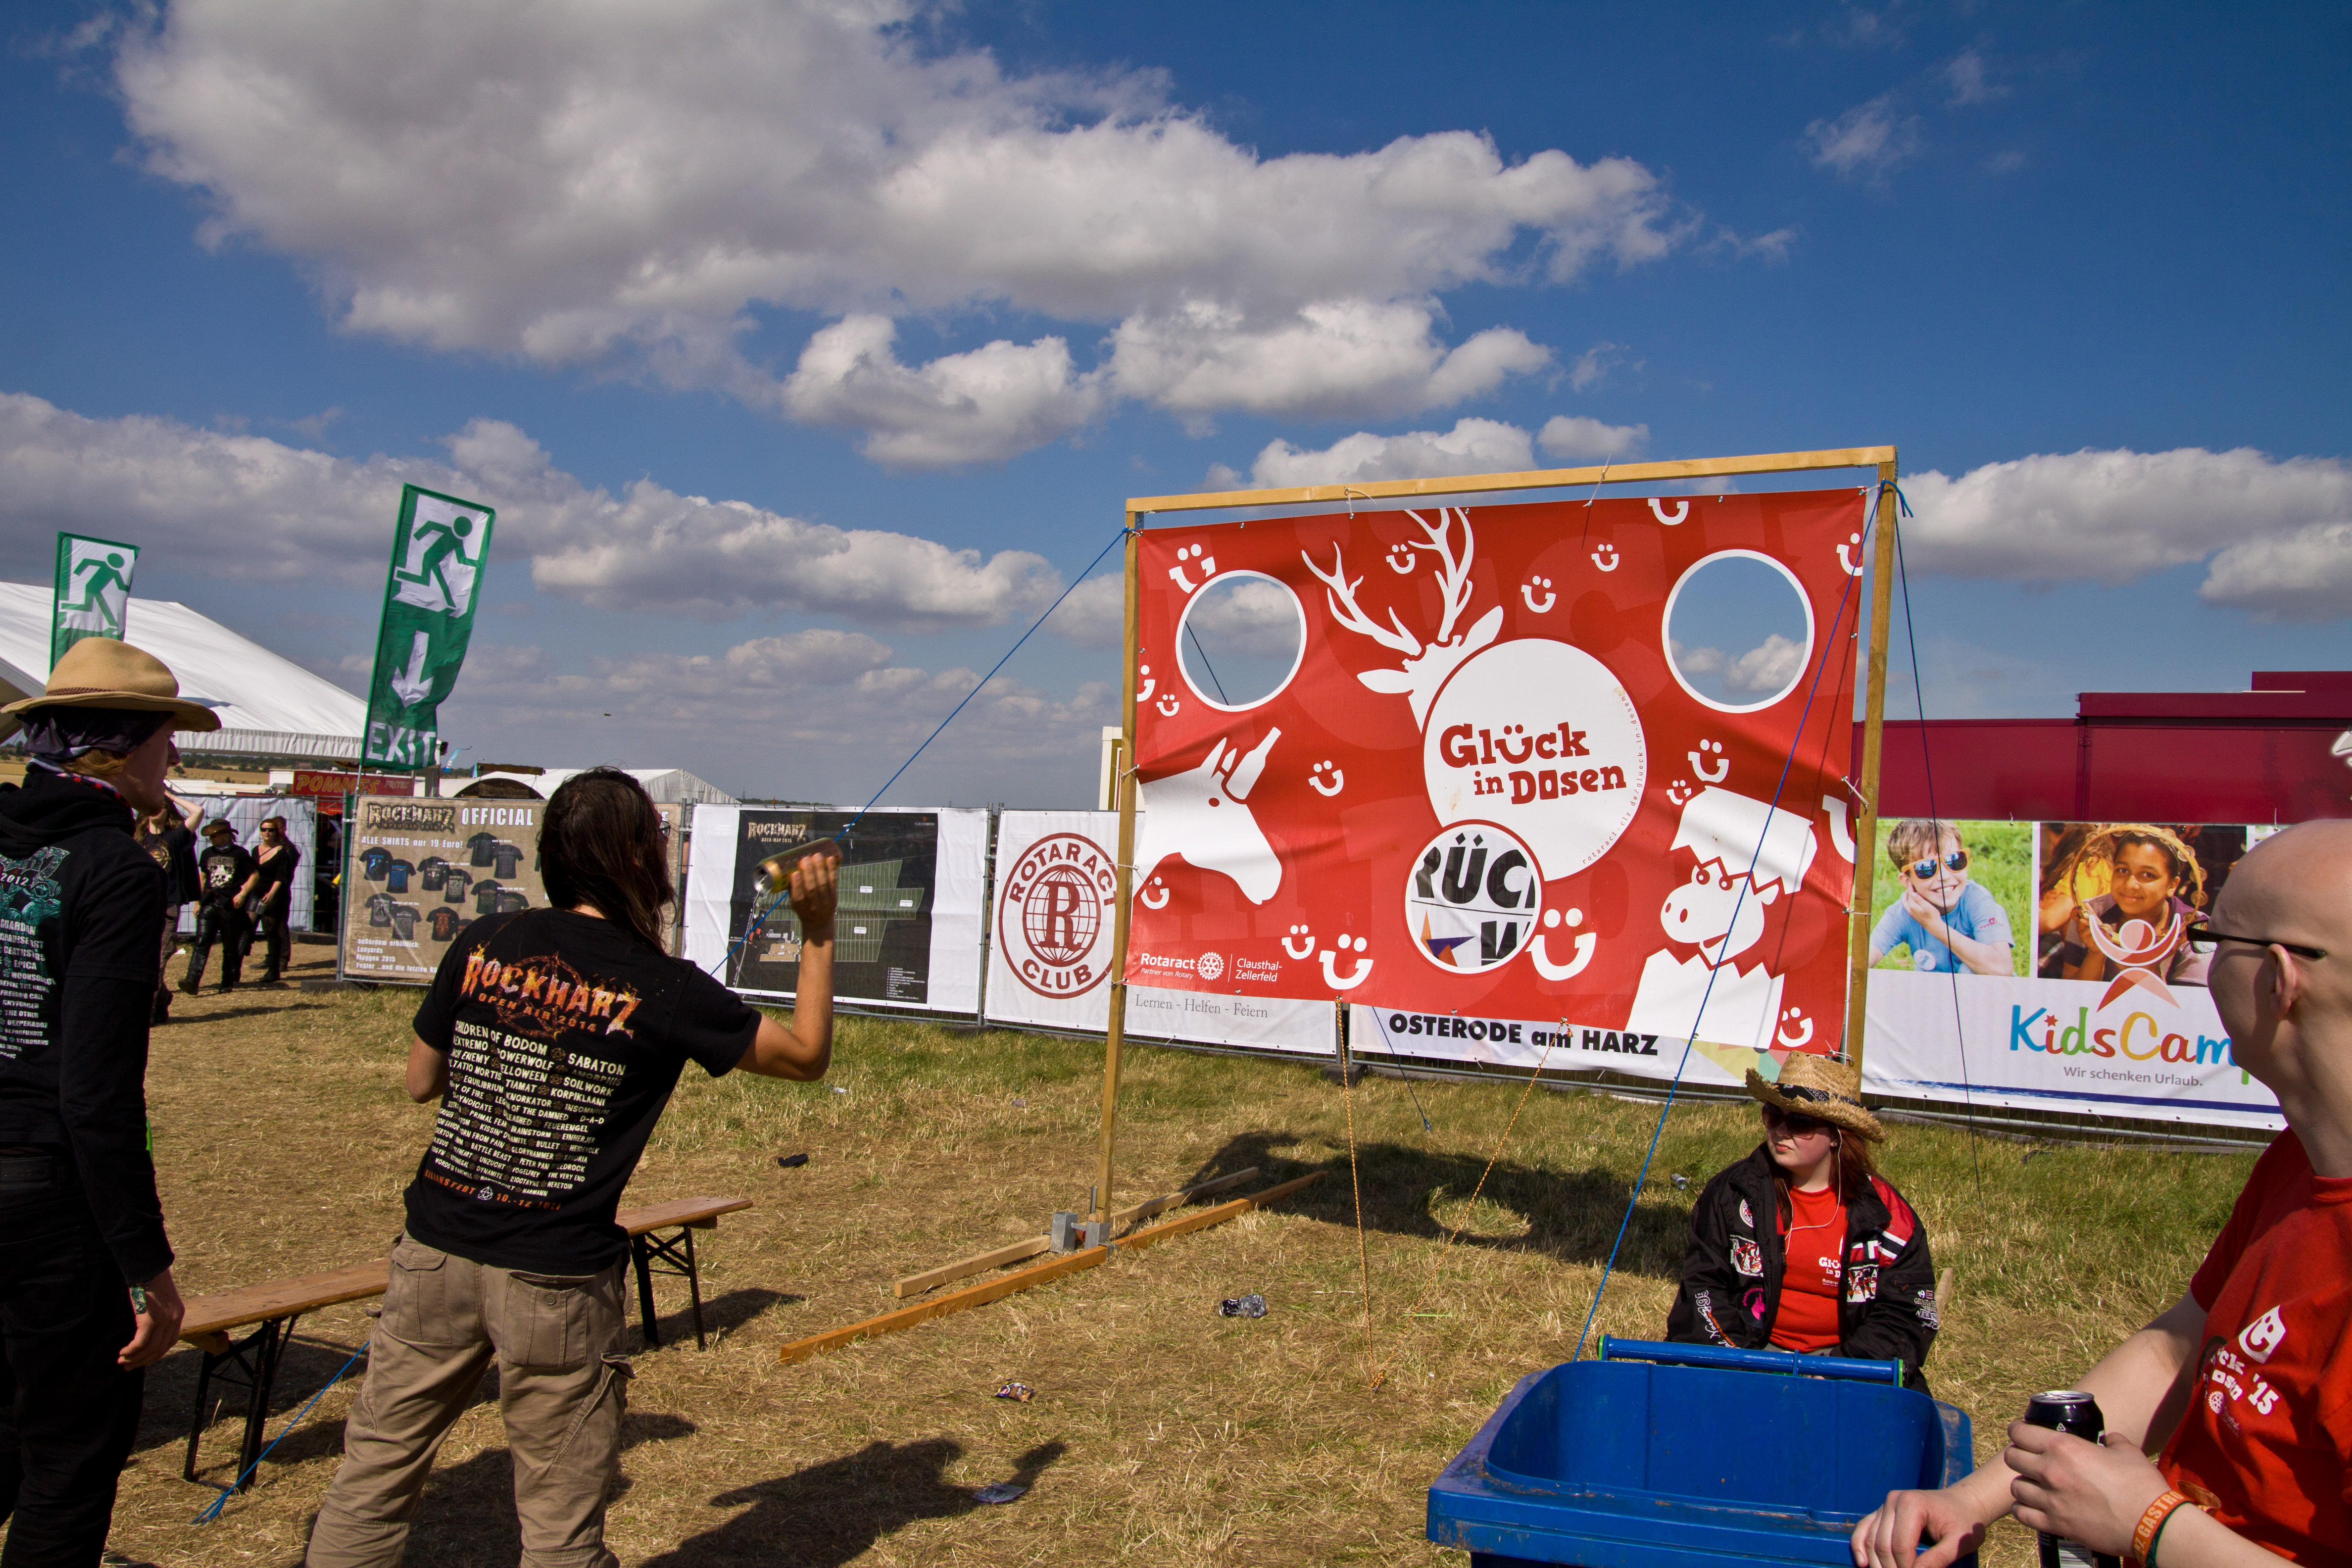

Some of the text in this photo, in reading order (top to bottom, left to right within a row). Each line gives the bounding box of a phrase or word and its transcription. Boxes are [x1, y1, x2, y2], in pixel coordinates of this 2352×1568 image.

[366, 721, 436, 767] EXIT
[1440, 722, 1590, 768] Glück
[296, 775, 410, 794] POMMES FRITES
[1473, 765, 1626, 805] in Dosen
[368, 804, 454, 833] ROCKHARZ
[461, 808, 534, 826] OFFICIAL
[361, 836, 378, 844] ALLE
[382, 837, 409, 846] SHIRTS
[442, 840, 463, 848] Euro!
[747, 822, 807, 843] ROCKHARZ
[0, 873, 29, 886] 2012
[1009, 842, 1116, 906] ROTARACT
[14, 960, 37, 970] EPICA
[1023, 959, 1092, 989] CLUB
[1140, 953, 1195, 970] Rotaract
[1175, 971, 1194, 980] Rotary
[1237, 958, 1282, 971] Clausthal-
[1235, 970, 1278, 982] Zellerfeld
[461, 953, 642, 1039] ROCKHARZ
[1135, 994, 1268, 1018] Lernen Helfen Feiern
[478, 993, 597, 1032] OPEN AIR 2014
[1389, 1013, 1659, 1056] OSTERODE am HARZ
[2009, 1004, 2250, 1085] KidsCam
[490, 1030, 502, 1043] OF
[504, 1034, 548, 1056] BODOM
[568, 1053, 627, 1076] SABATON
[461, 1051, 490, 1065] ENEMY
[500, 1063, 548, 1082] ELLOWEEN
[563, 1077, 614, 1097] SOILWORK
[474, 1066, 502, 1080] MORTIS
[505, 1079, 538, 1093] TIAMAT
[550, 1088, 606, 1106] KORPIKLAANI
[571, 1070, 623, 1086] AMORPHIS
[2063, 1066, 2203, 1086] Wir schenken Urlaub.
[464, 1075, 610, 1115] EQUILIBRIUM KNORKATOR INSOMNIUM
[471, 1089, 484, 1099] FIRE
[523, 1107, 537, 1116] THE
[538, 1110, 569, 1121] DAMNED
[580, 1115, 604, 1125] D-A-D
[469, 1110, 492, 1123] PRIMAL
[493, 1118, 507, 1128] FEAR
[511, 1126, 551, 1138] BRAINSTORM
[543, 1122, 588, 1133] FEUERENGEL
[444, 1119, 460, 1131] SAVIOR
[472, 1132, 490, 1143] FROM
[490, 1138, 505, 1149] PAIN
[511, 1146, 554, 1160] GLORYHAMMER
[536, 1140, 560, 1150] BULLET
[471, 1142, 493, 1155] BATTLE
[492, 1149, 512, 1162] BEAST
[520, 1158, 536, 1167] PETER
[538, 1162, 550, 1170] PAN
[435, 1157, 450, 1169] WORDS
[522, 1188, 548, 1197] HARMANN
[476, 1166, 503, 1179] DYNAMITE
[547, 1181, 573, 1189] HERETOIR
[2137, 1490, 2185, 1538] GASTRO
